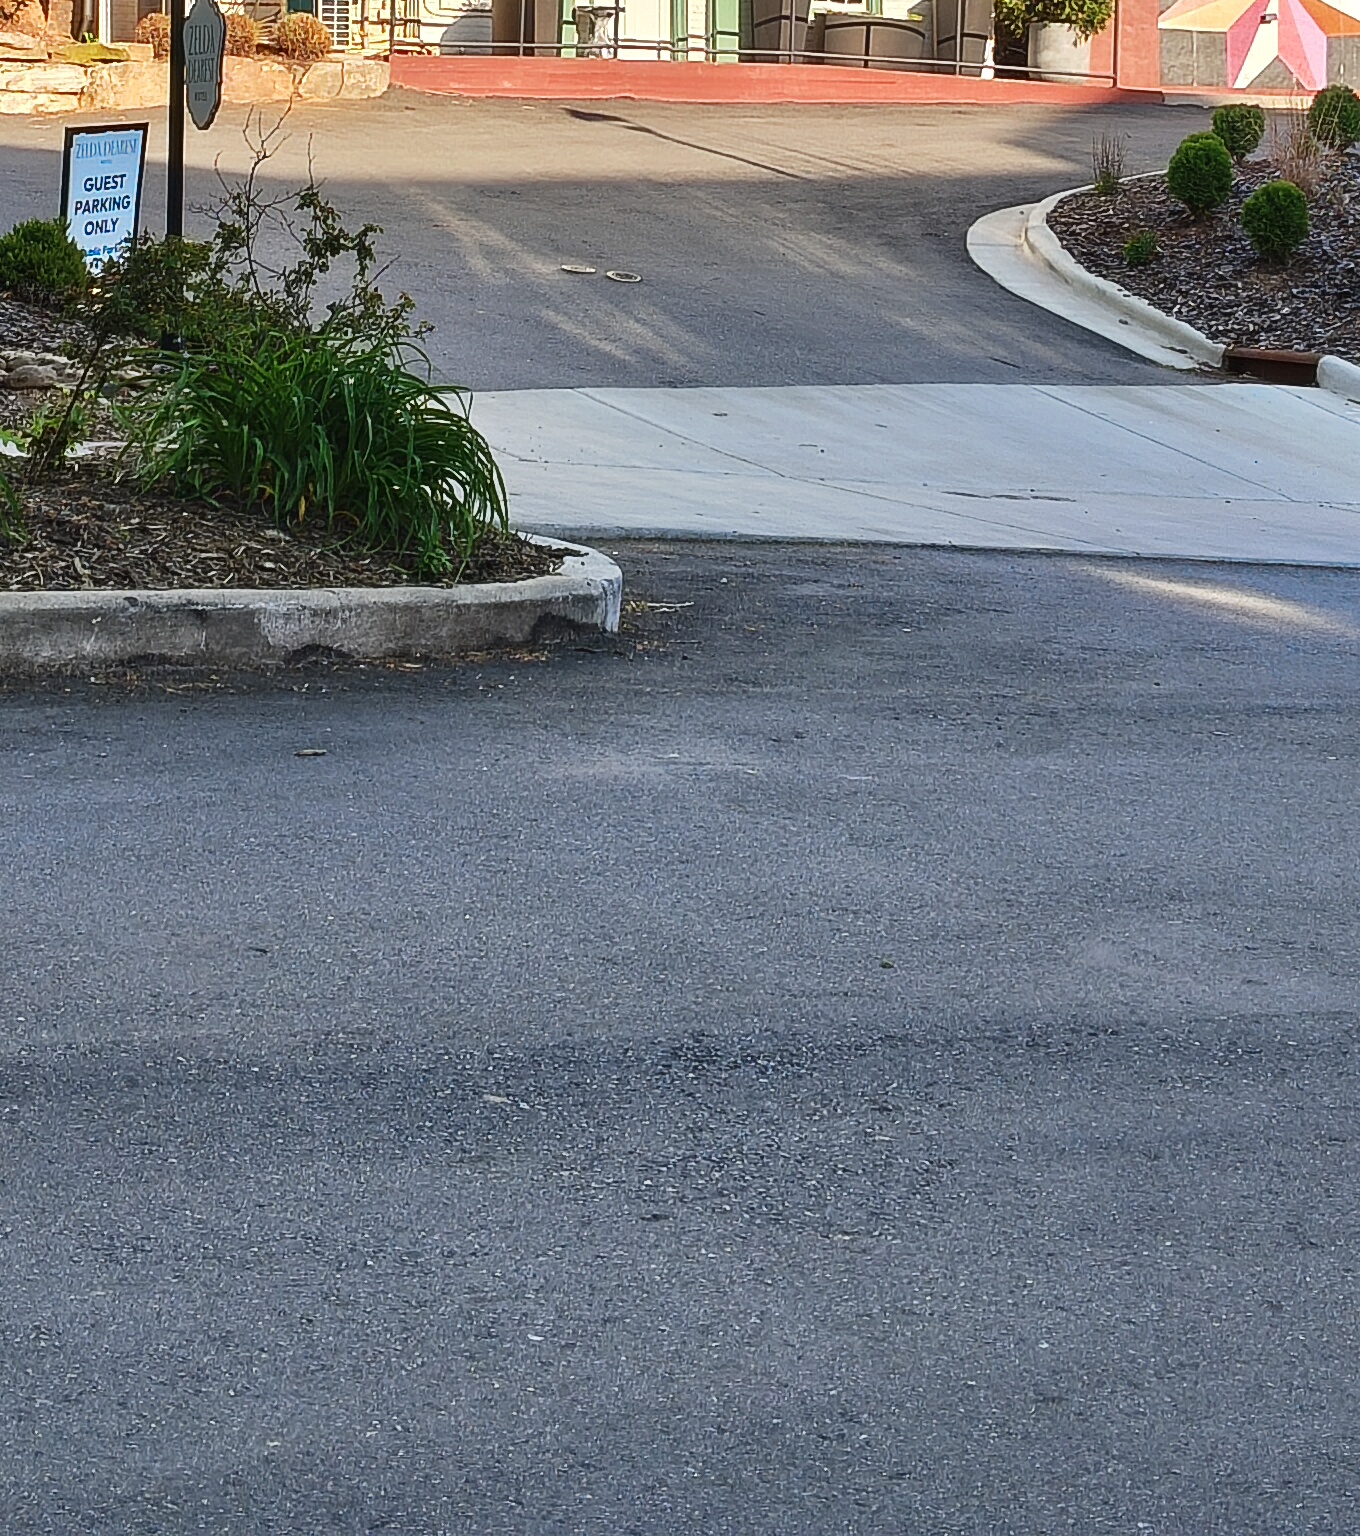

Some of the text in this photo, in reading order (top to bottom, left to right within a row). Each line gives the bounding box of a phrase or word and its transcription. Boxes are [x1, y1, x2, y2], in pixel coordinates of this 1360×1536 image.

[188, 23, 215, 56] ZELDA
[188, 57, 215, 84] DEAREST
[76, 138, 138, 159] ZELDA DEAREST
[83, 174, 127, 192] GUEST
[74, 195, 131, 216] PARKING
[84, 218, 119, 236] ONLY
